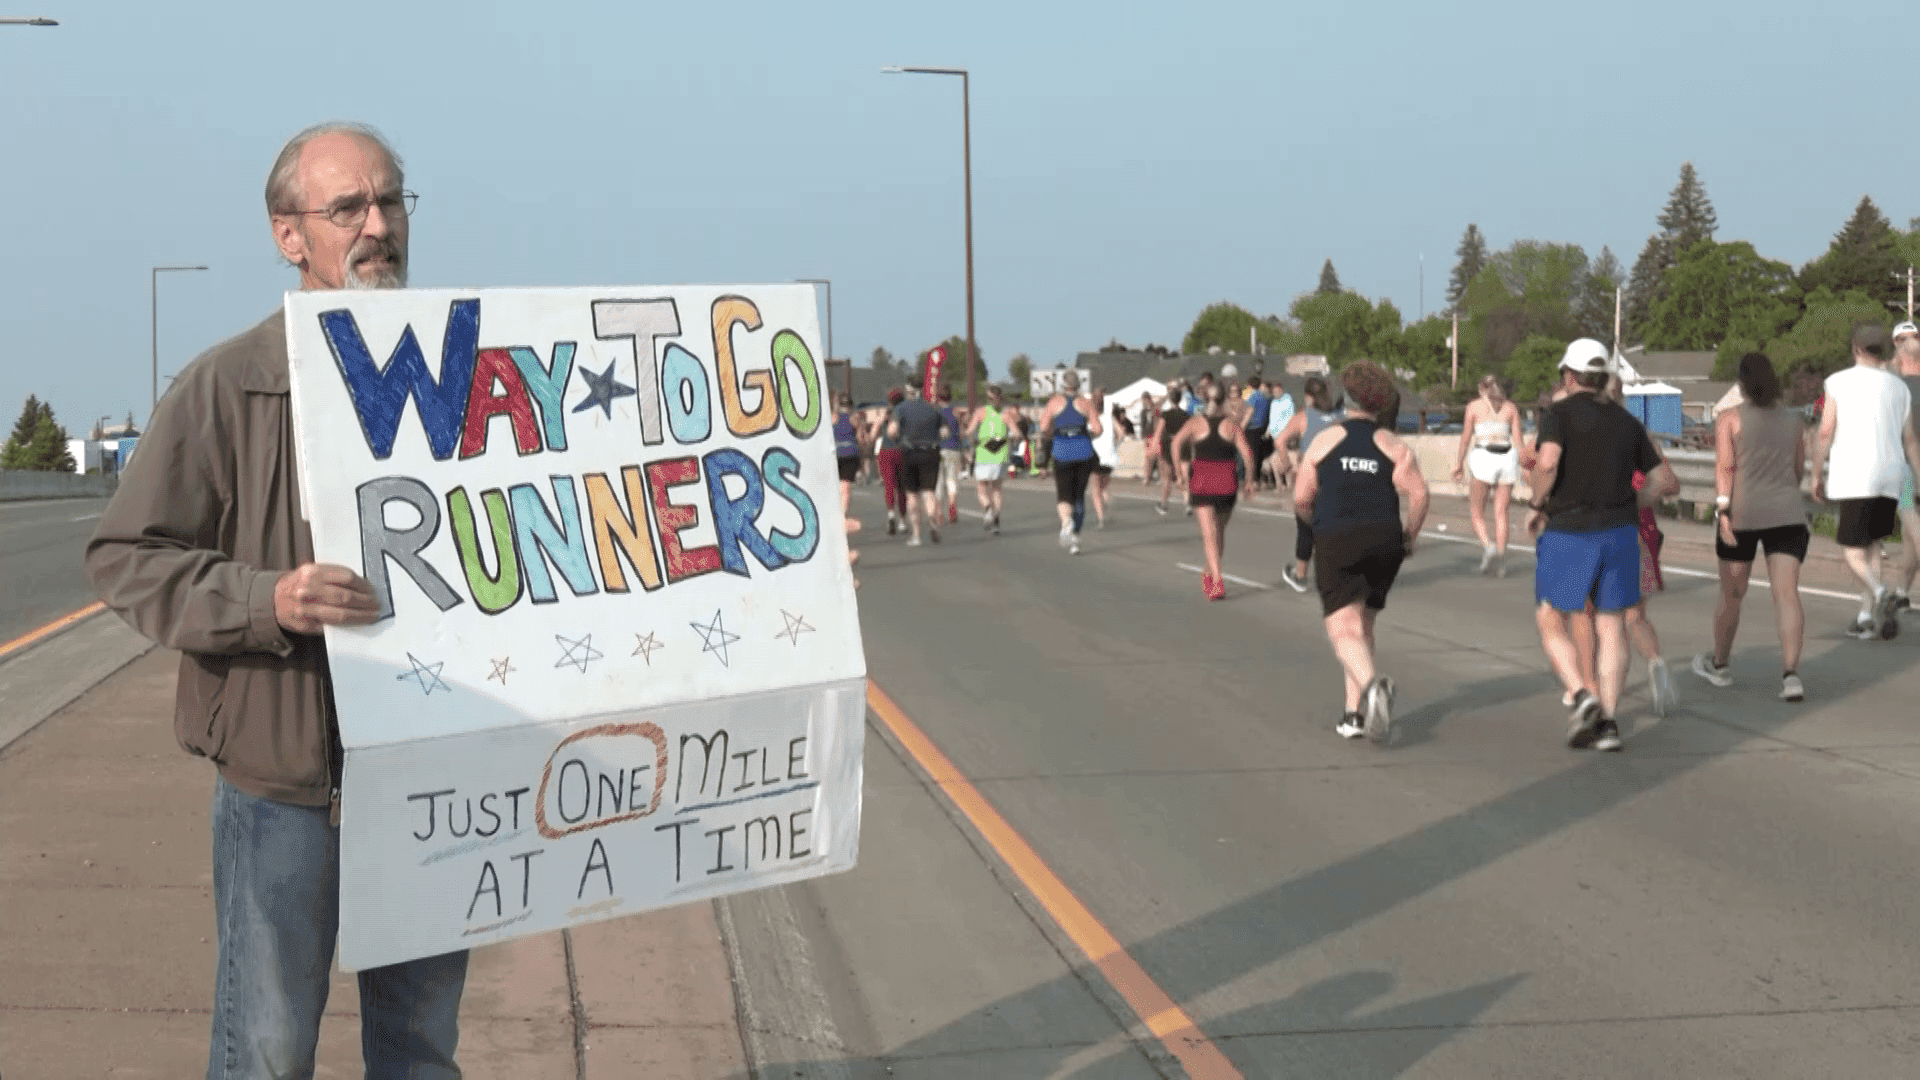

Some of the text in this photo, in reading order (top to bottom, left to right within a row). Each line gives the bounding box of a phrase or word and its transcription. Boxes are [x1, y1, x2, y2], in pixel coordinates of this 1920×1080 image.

[318, 294, 822, 461] WAY TO GO
[1340, 457, 1378, 473] TCRC
[355, 447, 820, 618] RUNNERS
[407, 729, 809, 842] JUST ONE MILE
[466, 809, 813, 920] AT A TIME
